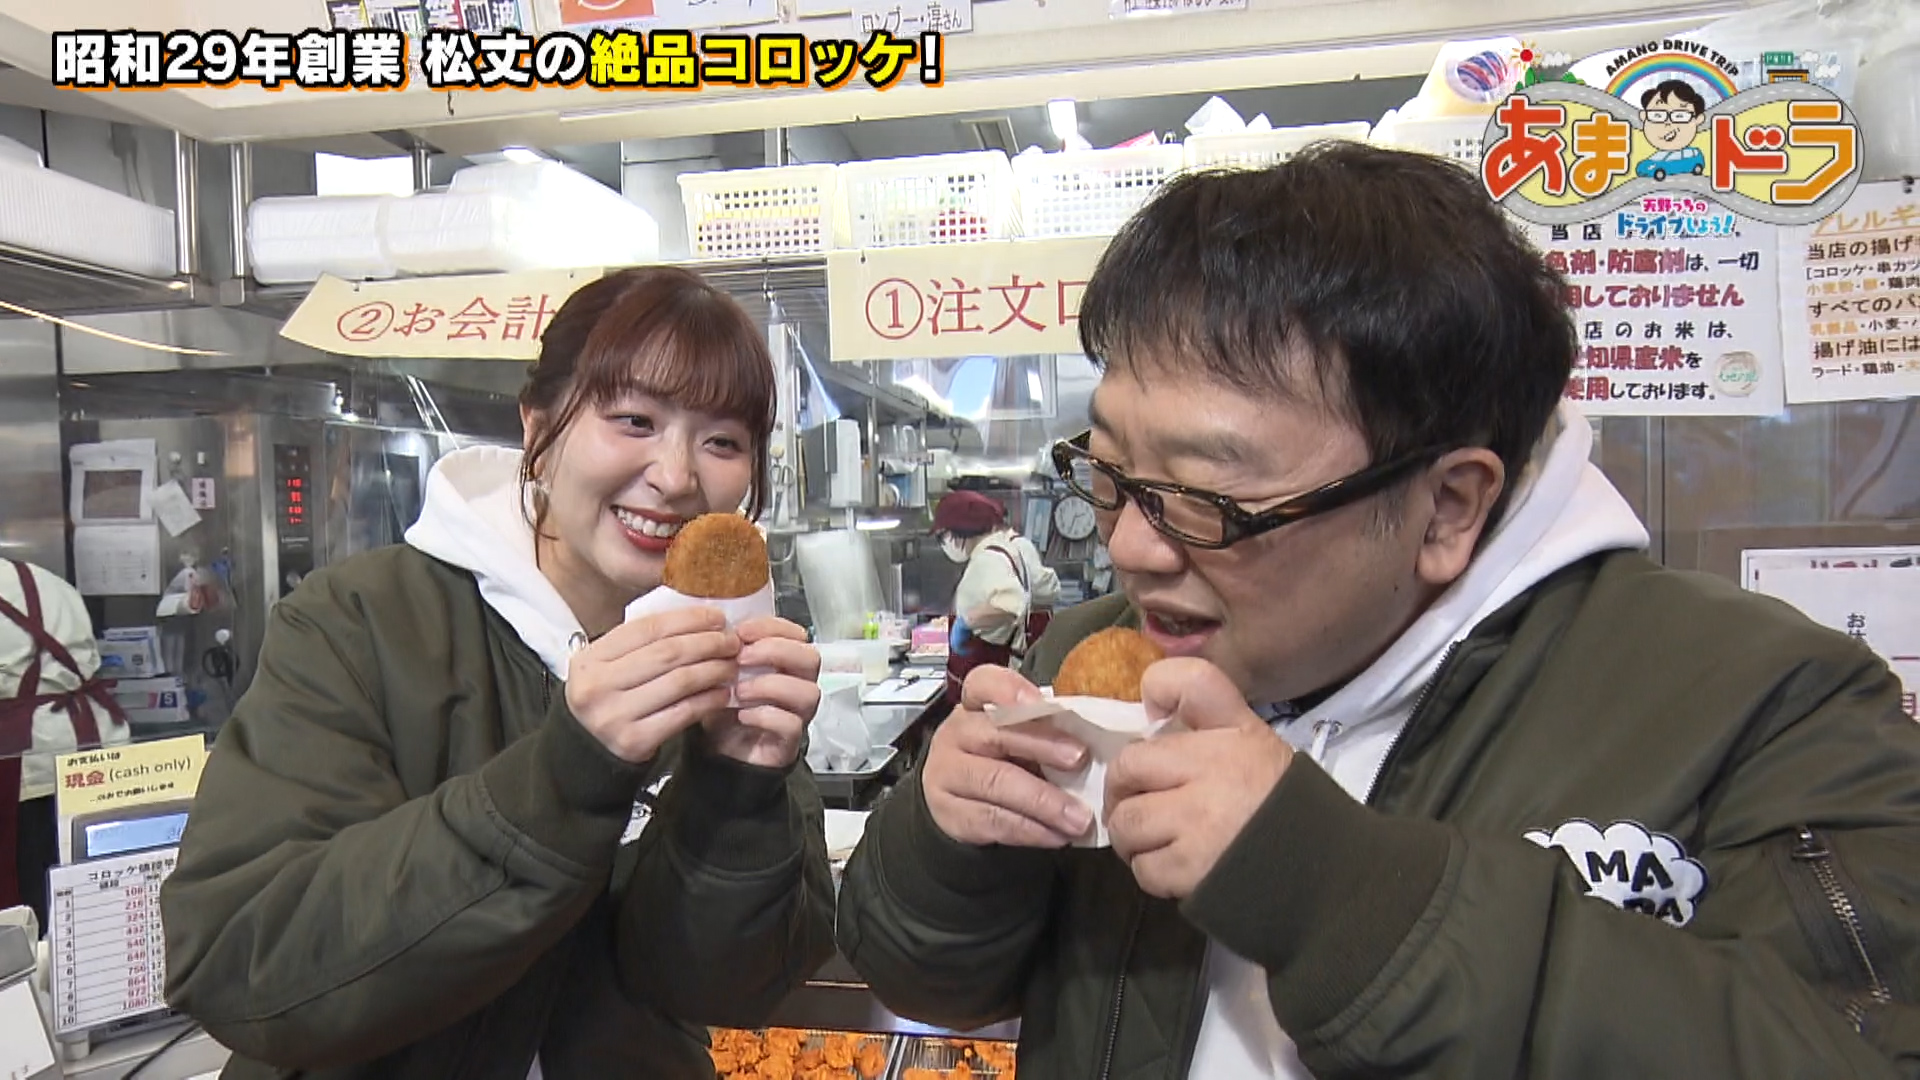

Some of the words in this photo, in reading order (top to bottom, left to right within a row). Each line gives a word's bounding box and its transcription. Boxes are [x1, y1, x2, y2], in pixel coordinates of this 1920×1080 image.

[1808, 234, 1920, 260] 当店の揚げ
[337, 294, 556, 343] ②お会計
[65, 769, 105, 789] 現金
[109, 763, 150, 783] (cash
[154, 755, 192, 774] only)
[1585, 849, 1674, 892] MA
